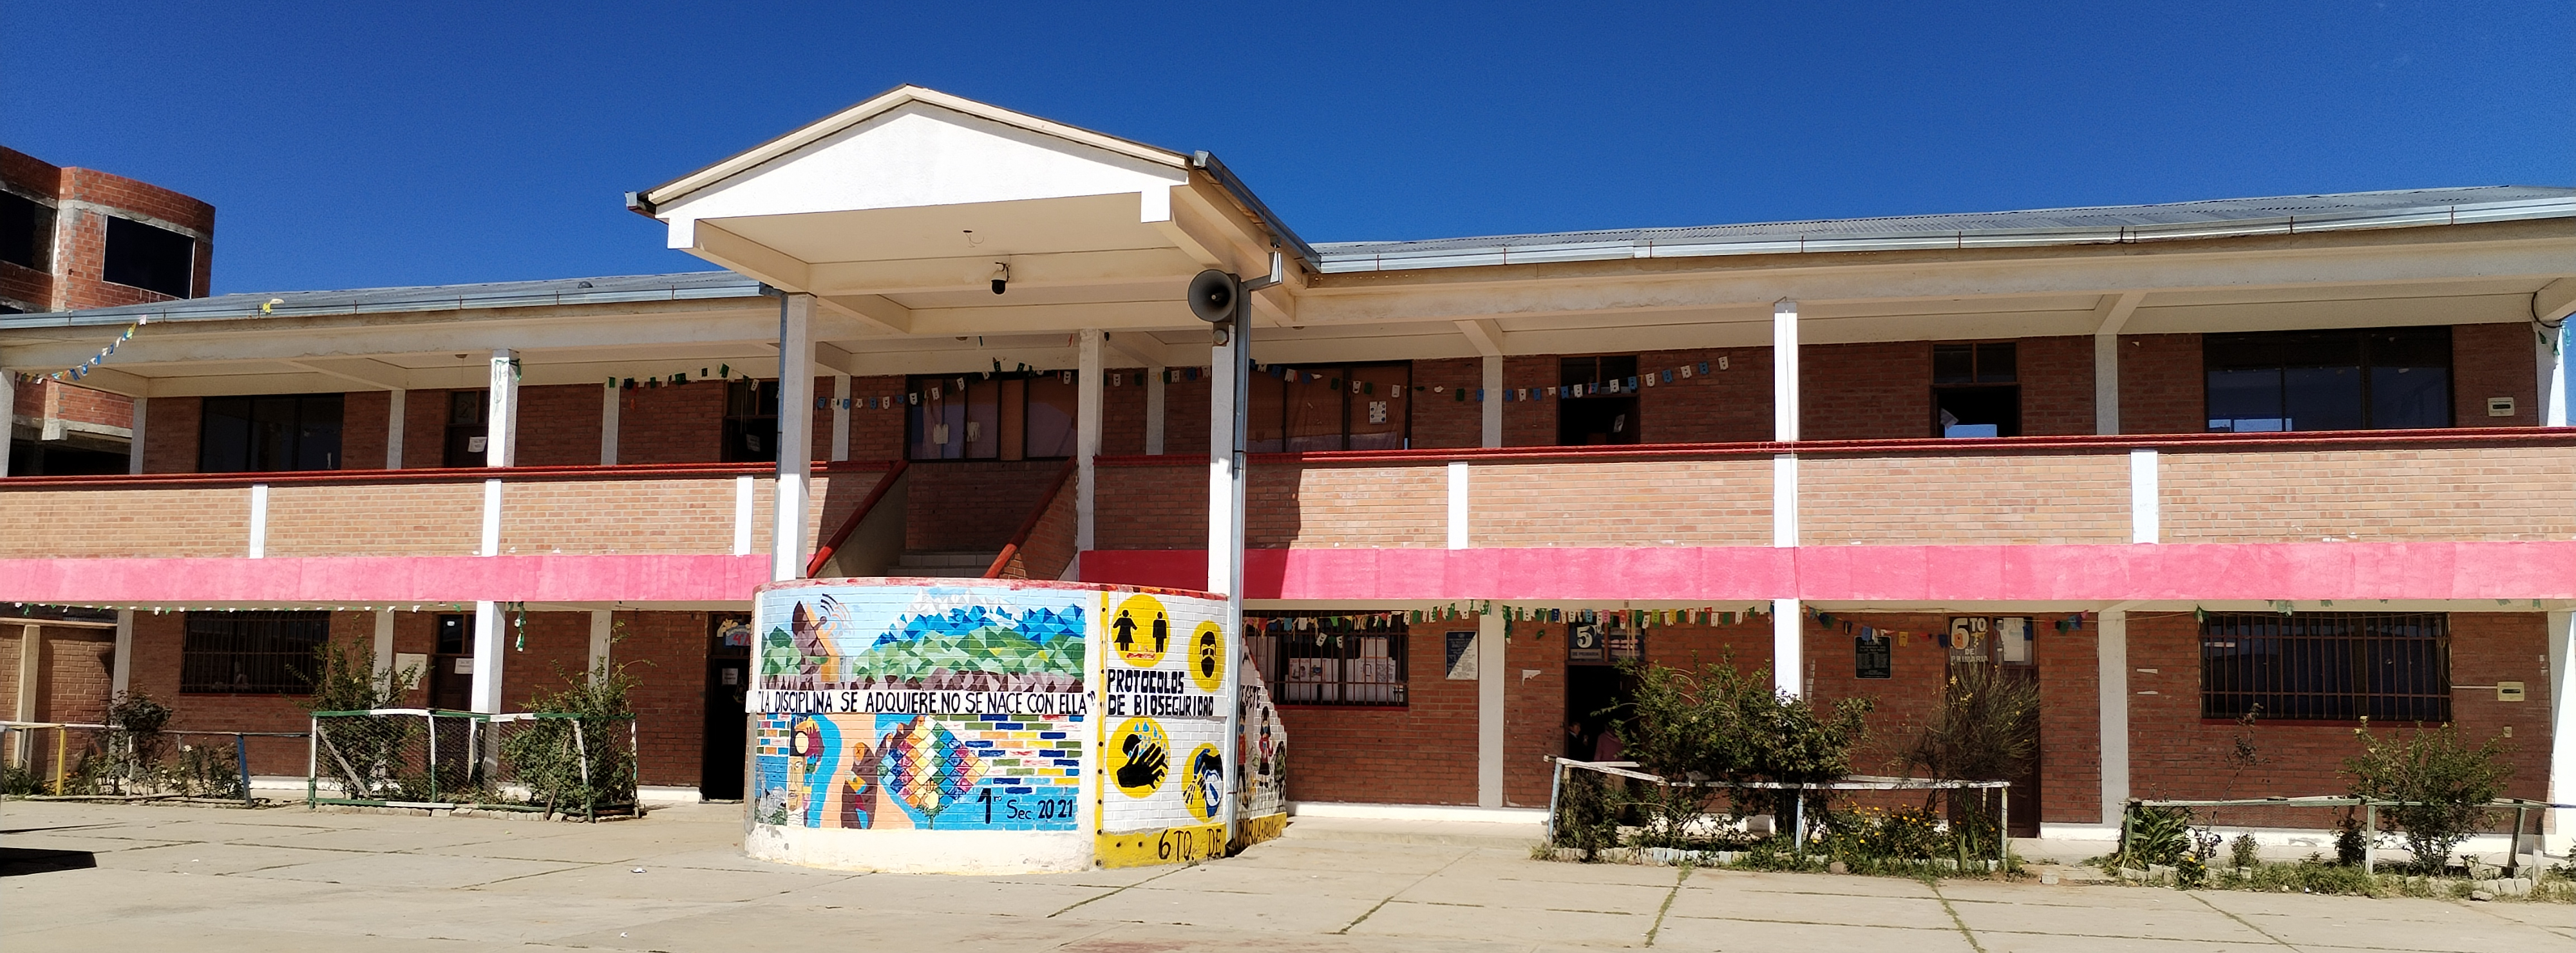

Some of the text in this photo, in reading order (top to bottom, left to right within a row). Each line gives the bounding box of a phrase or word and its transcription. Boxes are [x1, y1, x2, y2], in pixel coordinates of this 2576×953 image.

[1107, 669, 1184, 694] PROTOCOLOS
[775, 691, 833, 713] DISCIPLINA
[840, 692, 858, 713] SE
[942, 692, 960, 713] NO
[965, 692, 983, 713] SE
[988, 692, 1023, 714] NACE
[1027, 693, 1054, 714] CON
[1108, 694, 1214, 717] DE BIOSEGURIDAD
[1007, 799, 1035, 820] Sec.
[1206, 828, 1222, 860] DE
